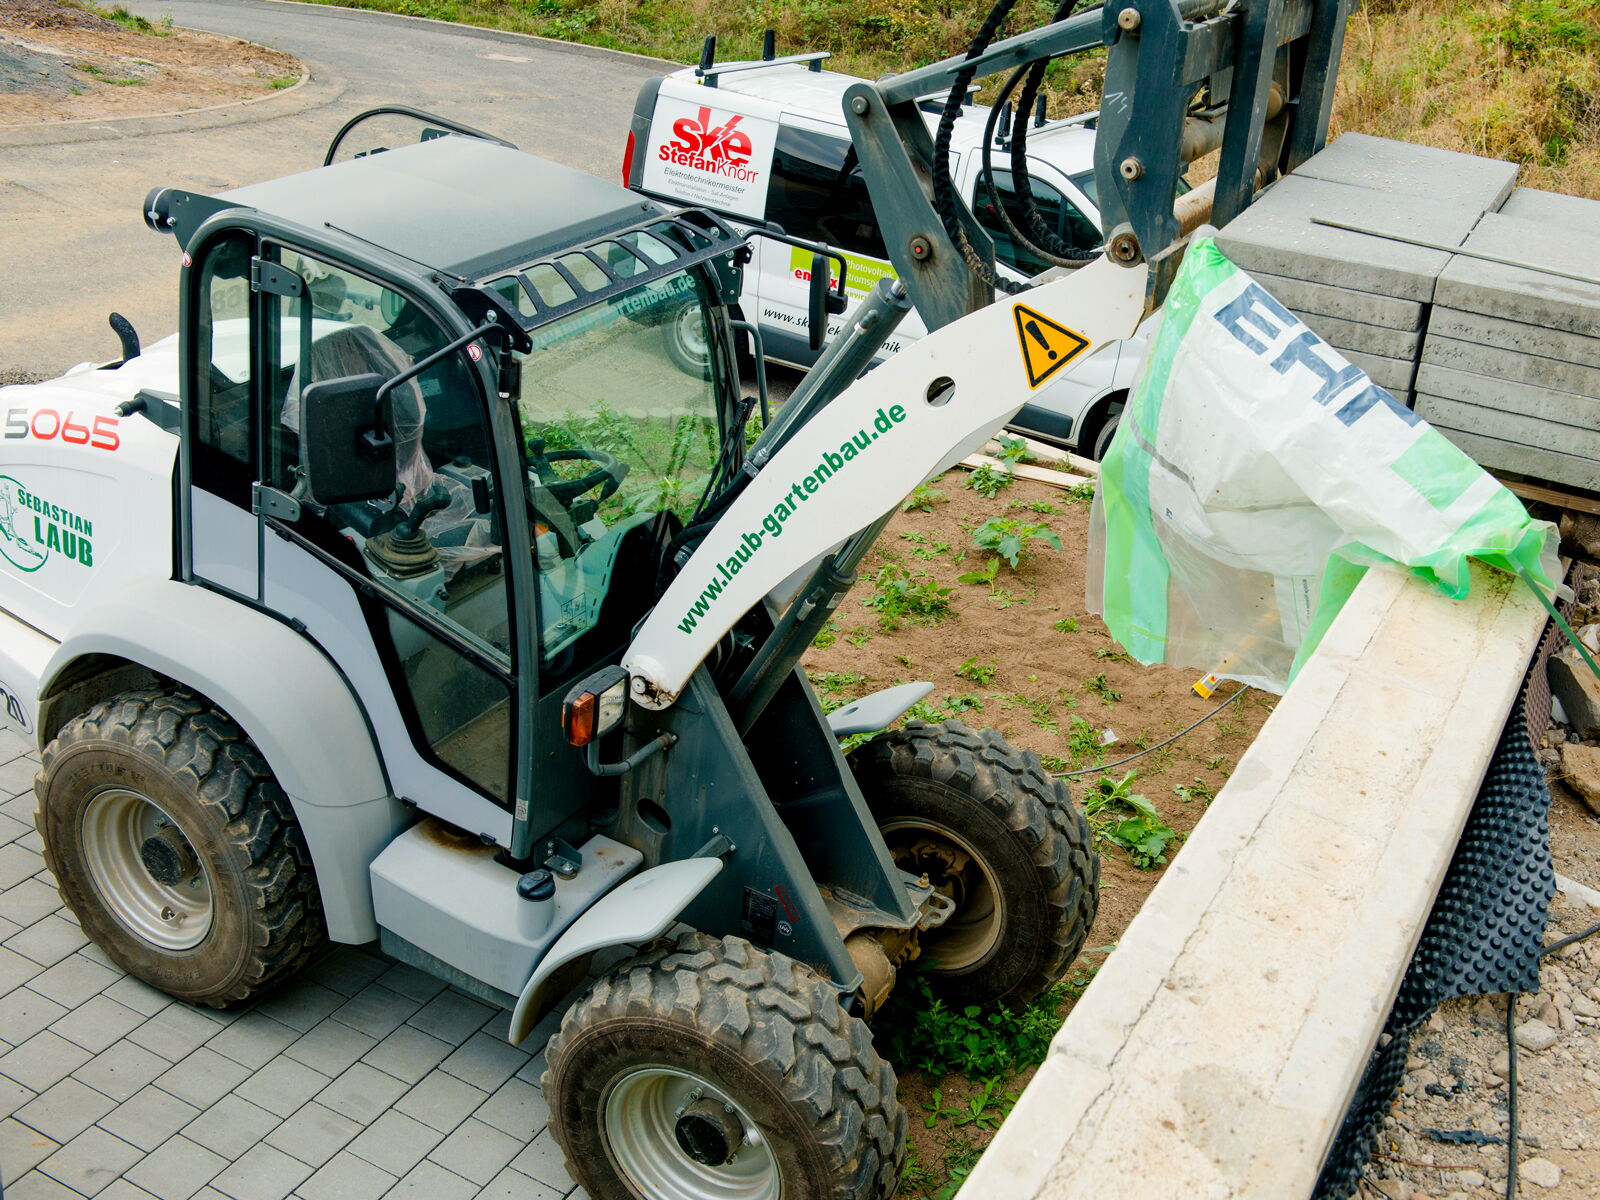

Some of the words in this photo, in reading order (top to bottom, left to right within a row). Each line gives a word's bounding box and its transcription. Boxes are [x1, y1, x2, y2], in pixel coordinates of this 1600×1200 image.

[664, 167, 745, 194] Elektrotechnikermeister
[4, 408, 120, 451] 5065
[17, 488, 93, 537] SEBASTIAN
[677, 404, 907, 634] www.laub-gartenbau.de
[34, 516, 93, 567] LAUB
